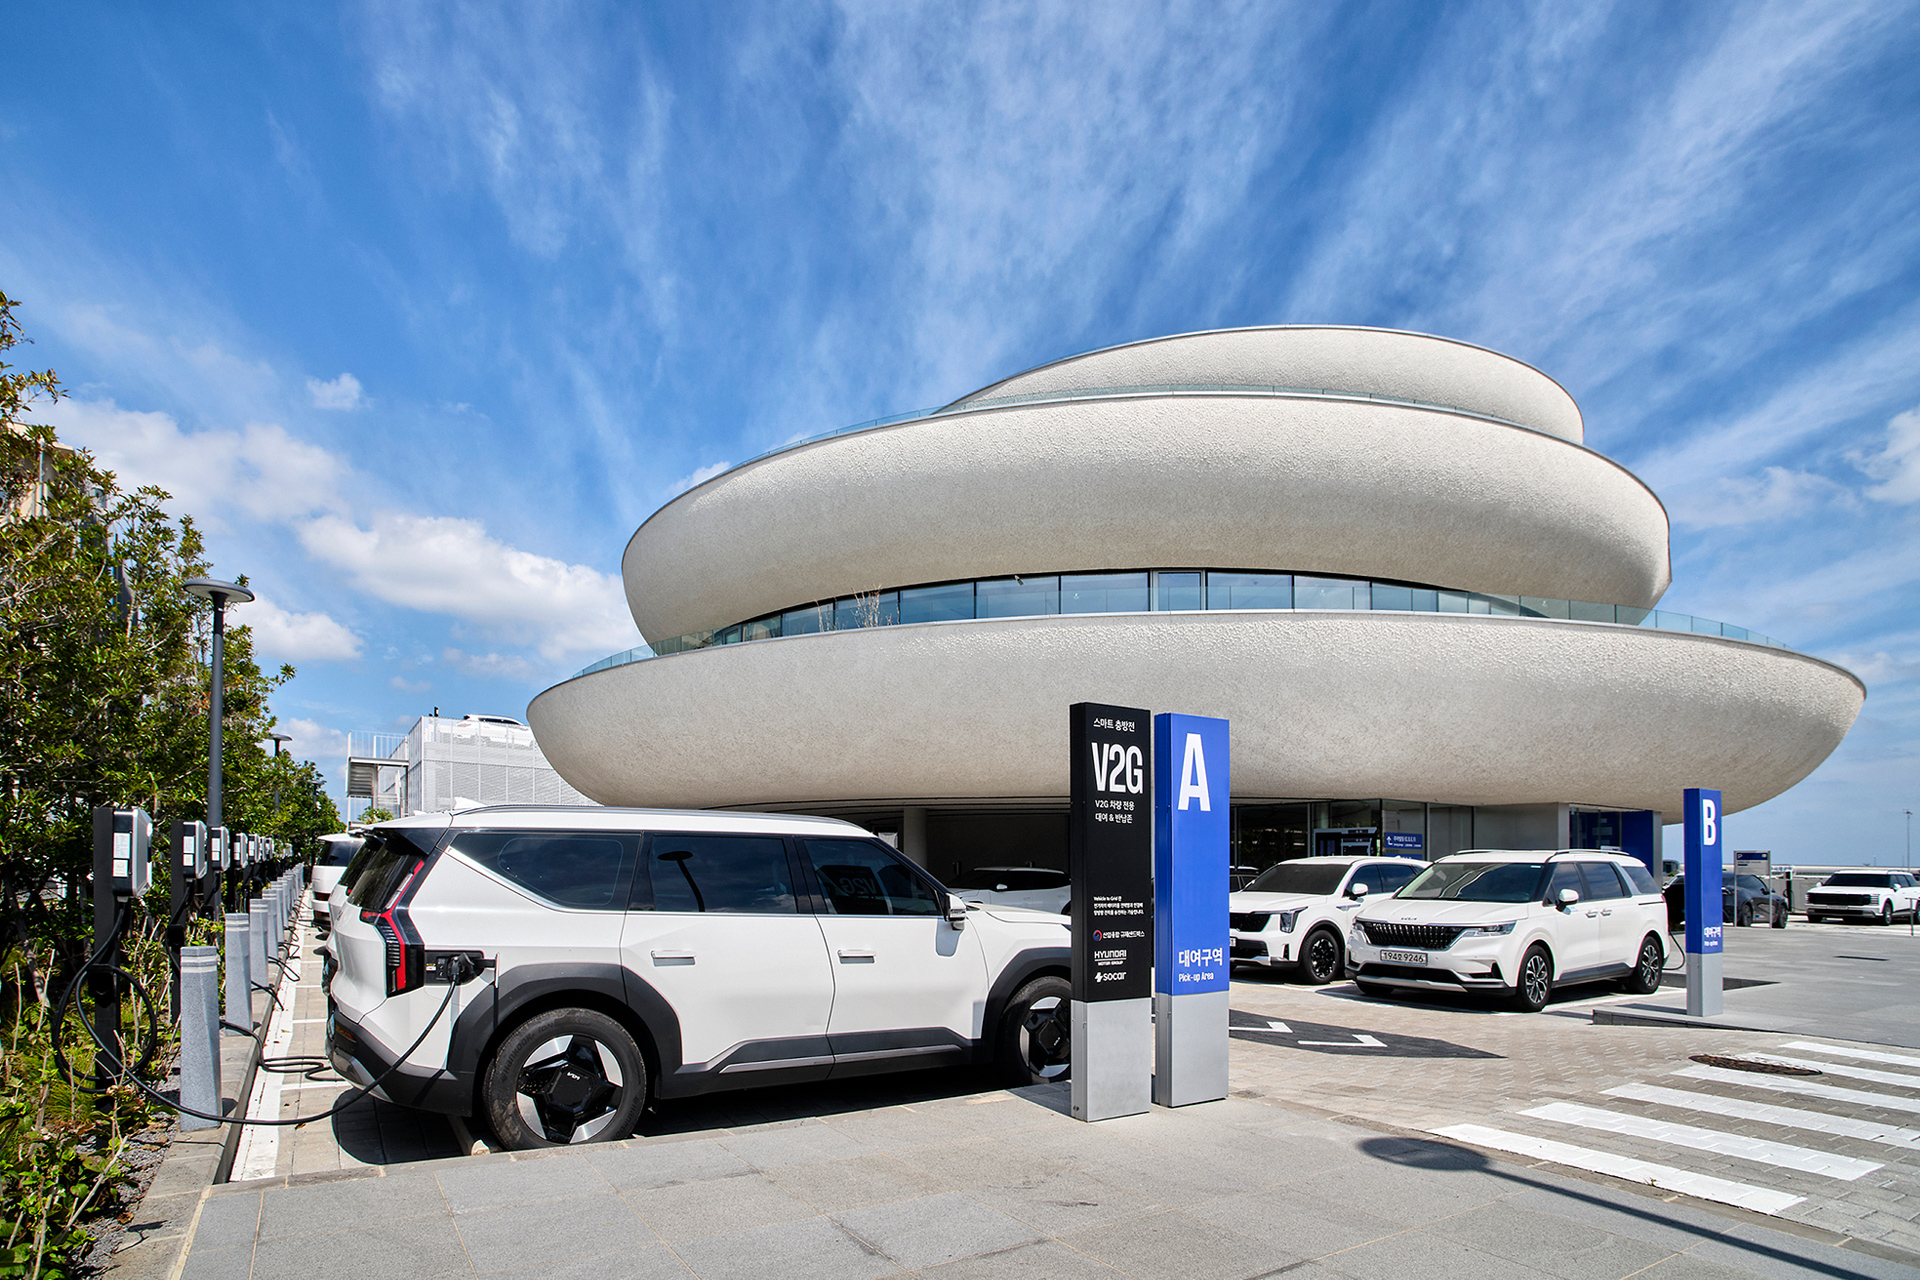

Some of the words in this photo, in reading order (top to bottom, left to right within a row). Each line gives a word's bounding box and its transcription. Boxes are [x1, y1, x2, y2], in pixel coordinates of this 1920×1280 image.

[1093, 718, 1114, 729] 스마트
[1115, 719, 1135, 732] 충방전
[1092, 742, 1144, 794] V2G
[1178, 732, 1211, 812] A
[1094, 800, 1108, 808] V2G
[1110, 800, 1122, 810] 차량
[1123, 801, 1134, 811] 전용
[1095, 812, 1108, 822] 대여
[1109, 814, 1114, 822] &
[1115, 814, 1132, 824] 반납존
[1702, 798, 1716, 846] B
[1094, 950, 1127, 958] HYUNDAI
[1178, 947, 1222, 968] 대여구역
[1404, 953, 1424, 962] 9246
[1103, 972, 1127, 982] socar
[1178, 973, 1200, 982] Pick-up
[1201, 972, 1214, 980] Area
